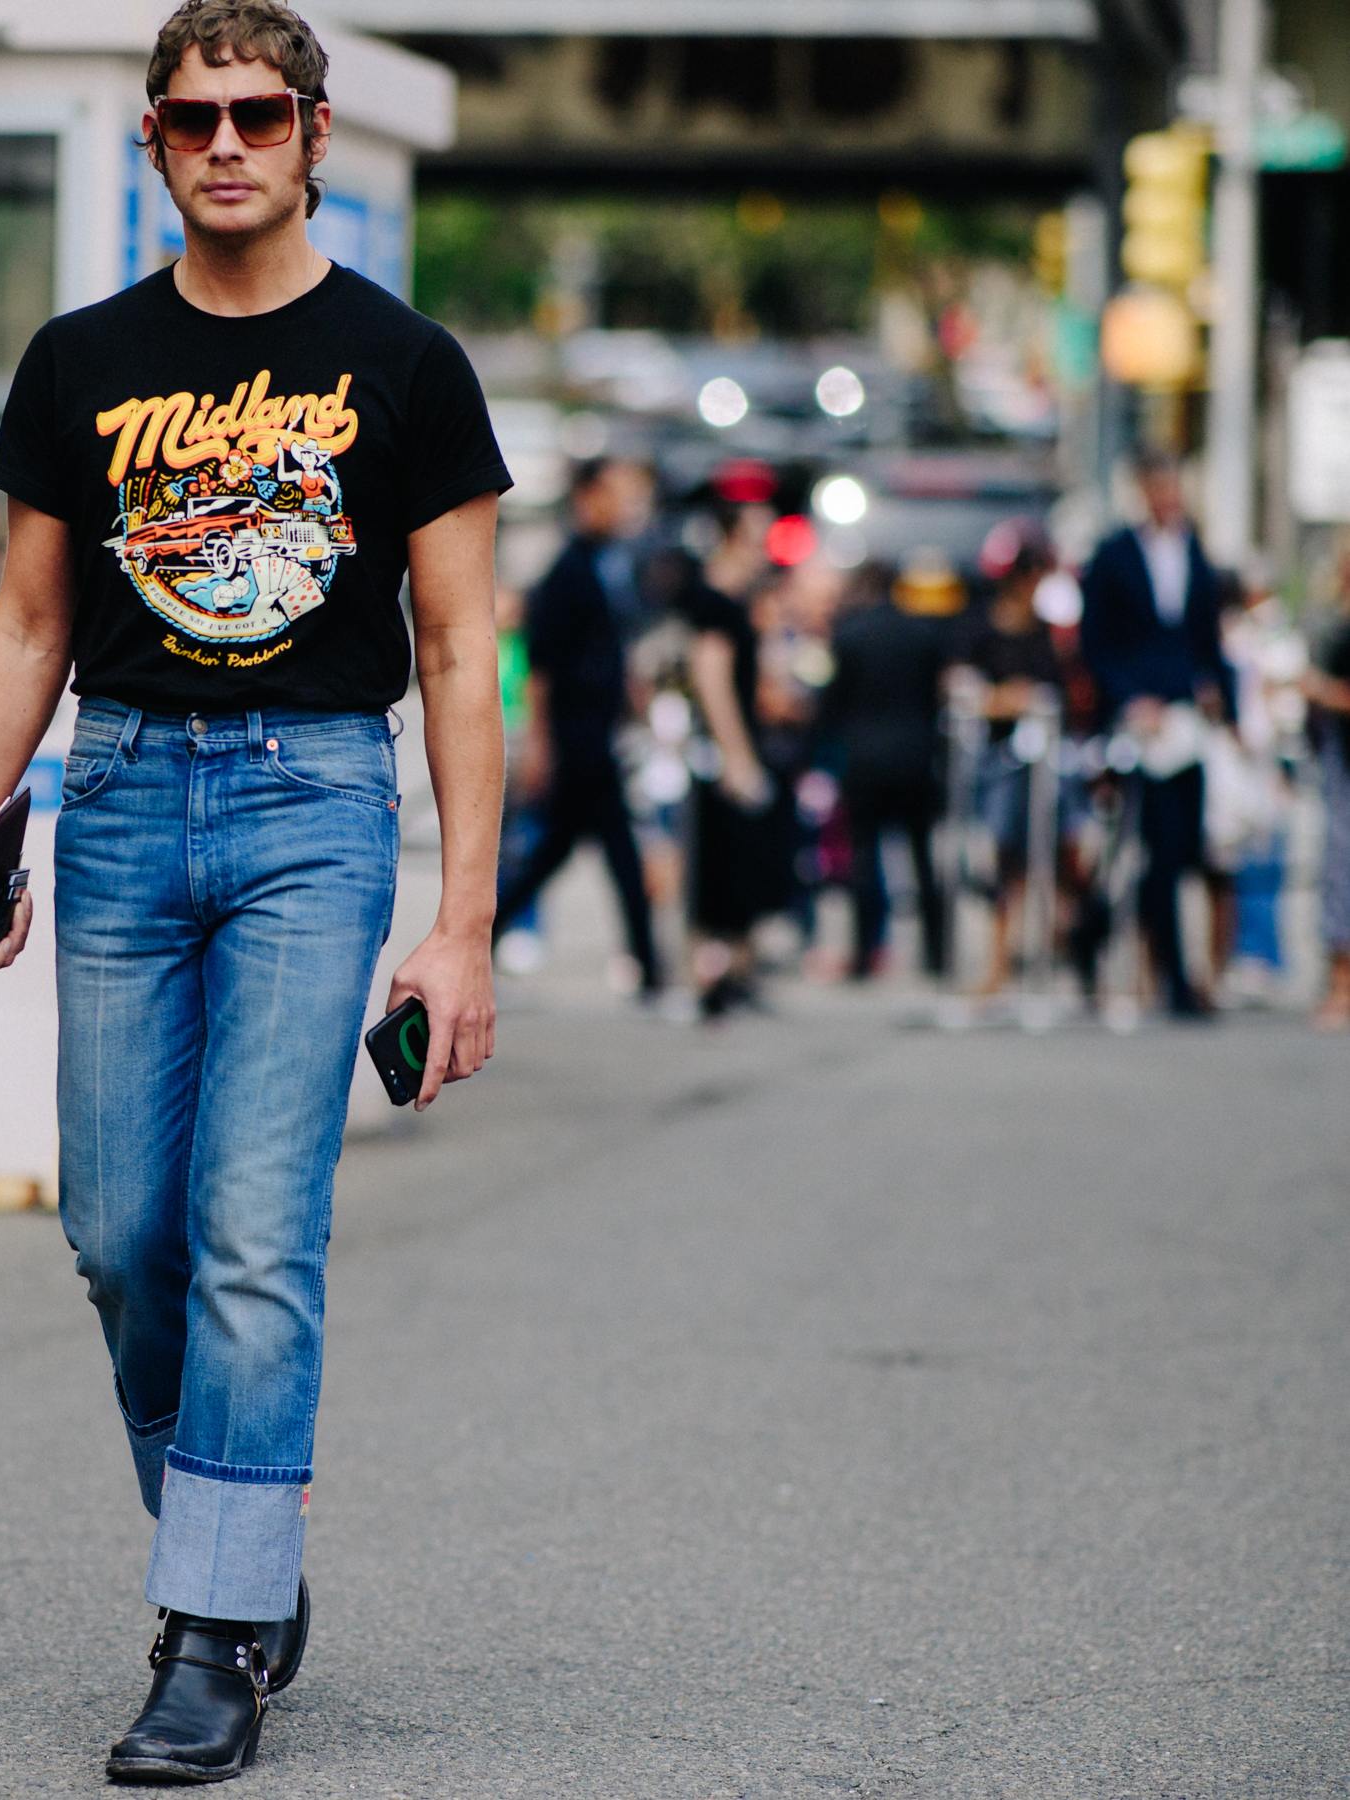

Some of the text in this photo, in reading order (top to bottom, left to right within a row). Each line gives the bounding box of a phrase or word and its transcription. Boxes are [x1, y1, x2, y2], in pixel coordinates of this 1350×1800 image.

[96, 369, 358, 487] Midland
[150, 586, 186, 616] PEOPLE
[189, 615, 206, 626] SAY
[209, 623, 230, 631] I'VE
[235, 621, 255, 630] GOT
[162, 634, 292, 667] Drinkin' Problem
